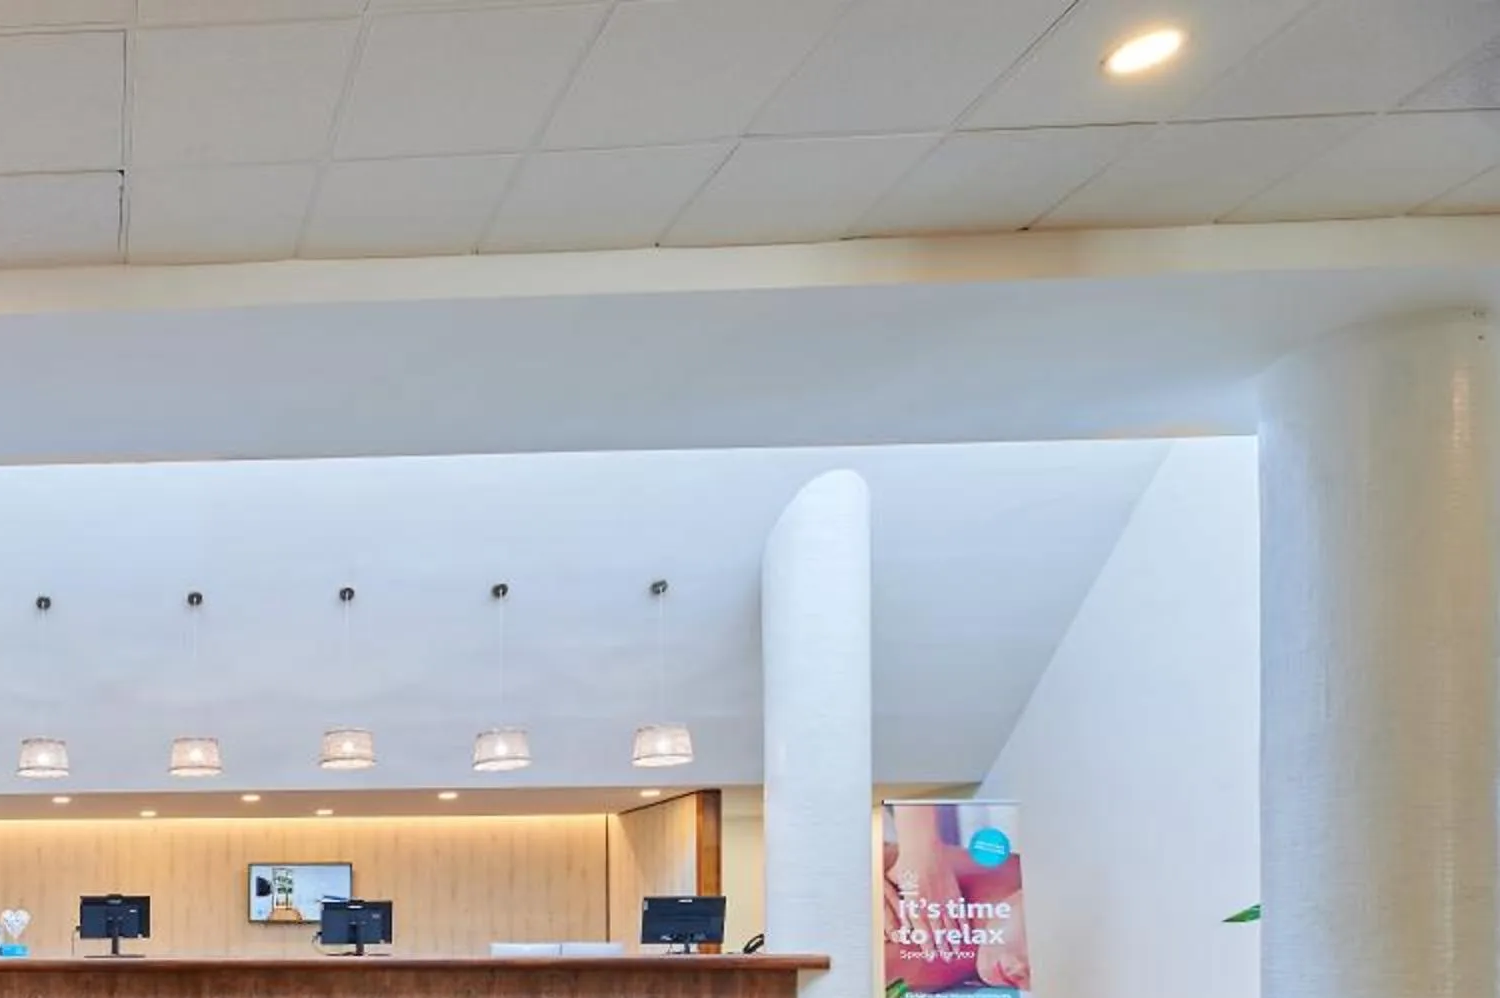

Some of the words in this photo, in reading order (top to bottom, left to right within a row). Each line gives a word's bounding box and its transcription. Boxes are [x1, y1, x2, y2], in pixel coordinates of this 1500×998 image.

[899, 898, 941, 919] It's
[946, 897, 1012, 919] time
[897, 926, 929, 945] to
[934, 923, 1005, 945] relax
